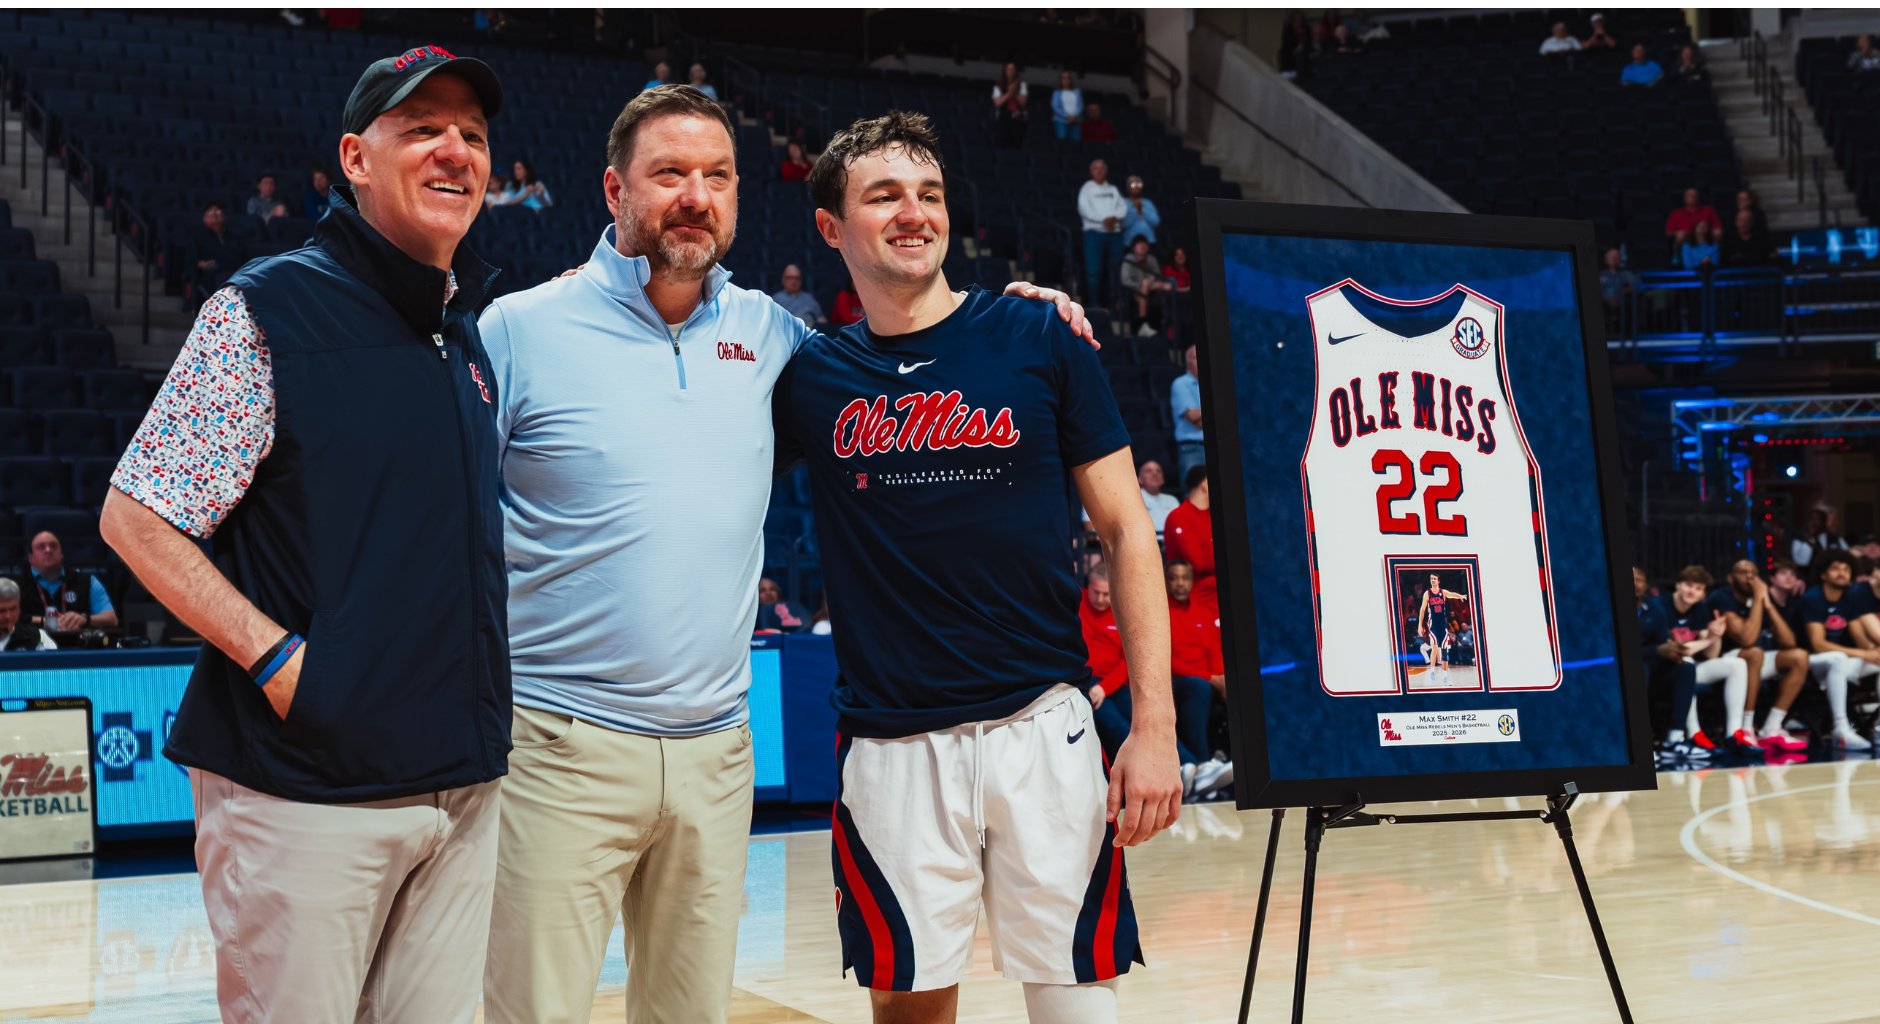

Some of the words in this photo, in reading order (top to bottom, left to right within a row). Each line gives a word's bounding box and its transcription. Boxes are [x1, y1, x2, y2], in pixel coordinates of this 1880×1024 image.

[394, 48, 427, 71] OLE
[1457, 319, 1481, 348] SEC
[717, 341, 733, 360] Ole
[730, 342, 756, 362] Miss
[1455, 343, 1485, 358] GRADUATE
[1329, 371, 1402, 448] OLE
[1411, 371, 1496, 455] MISS
[834, 394, 898, 458] Ole
[895, 389, 1020, 452] Miss
[878, 469, 964, 480] ENGINEERED
[977, 467, 1001, 475] FOR
[928, 474, 994, 483] BASKETBALL
[1371, 449, 1468, 537] 22
[1380, 718, 1392, 730] Ole
[1419, 715, 1436, 723] MAX
[1437, 714, 1460, 722] SMITH
[1461, 713, 1477, 721] #22
[1499, 715, 1514, 735] SEC
[1384, 730, 1402, 741] Miss
[0, 752, 87, 797] Miss
